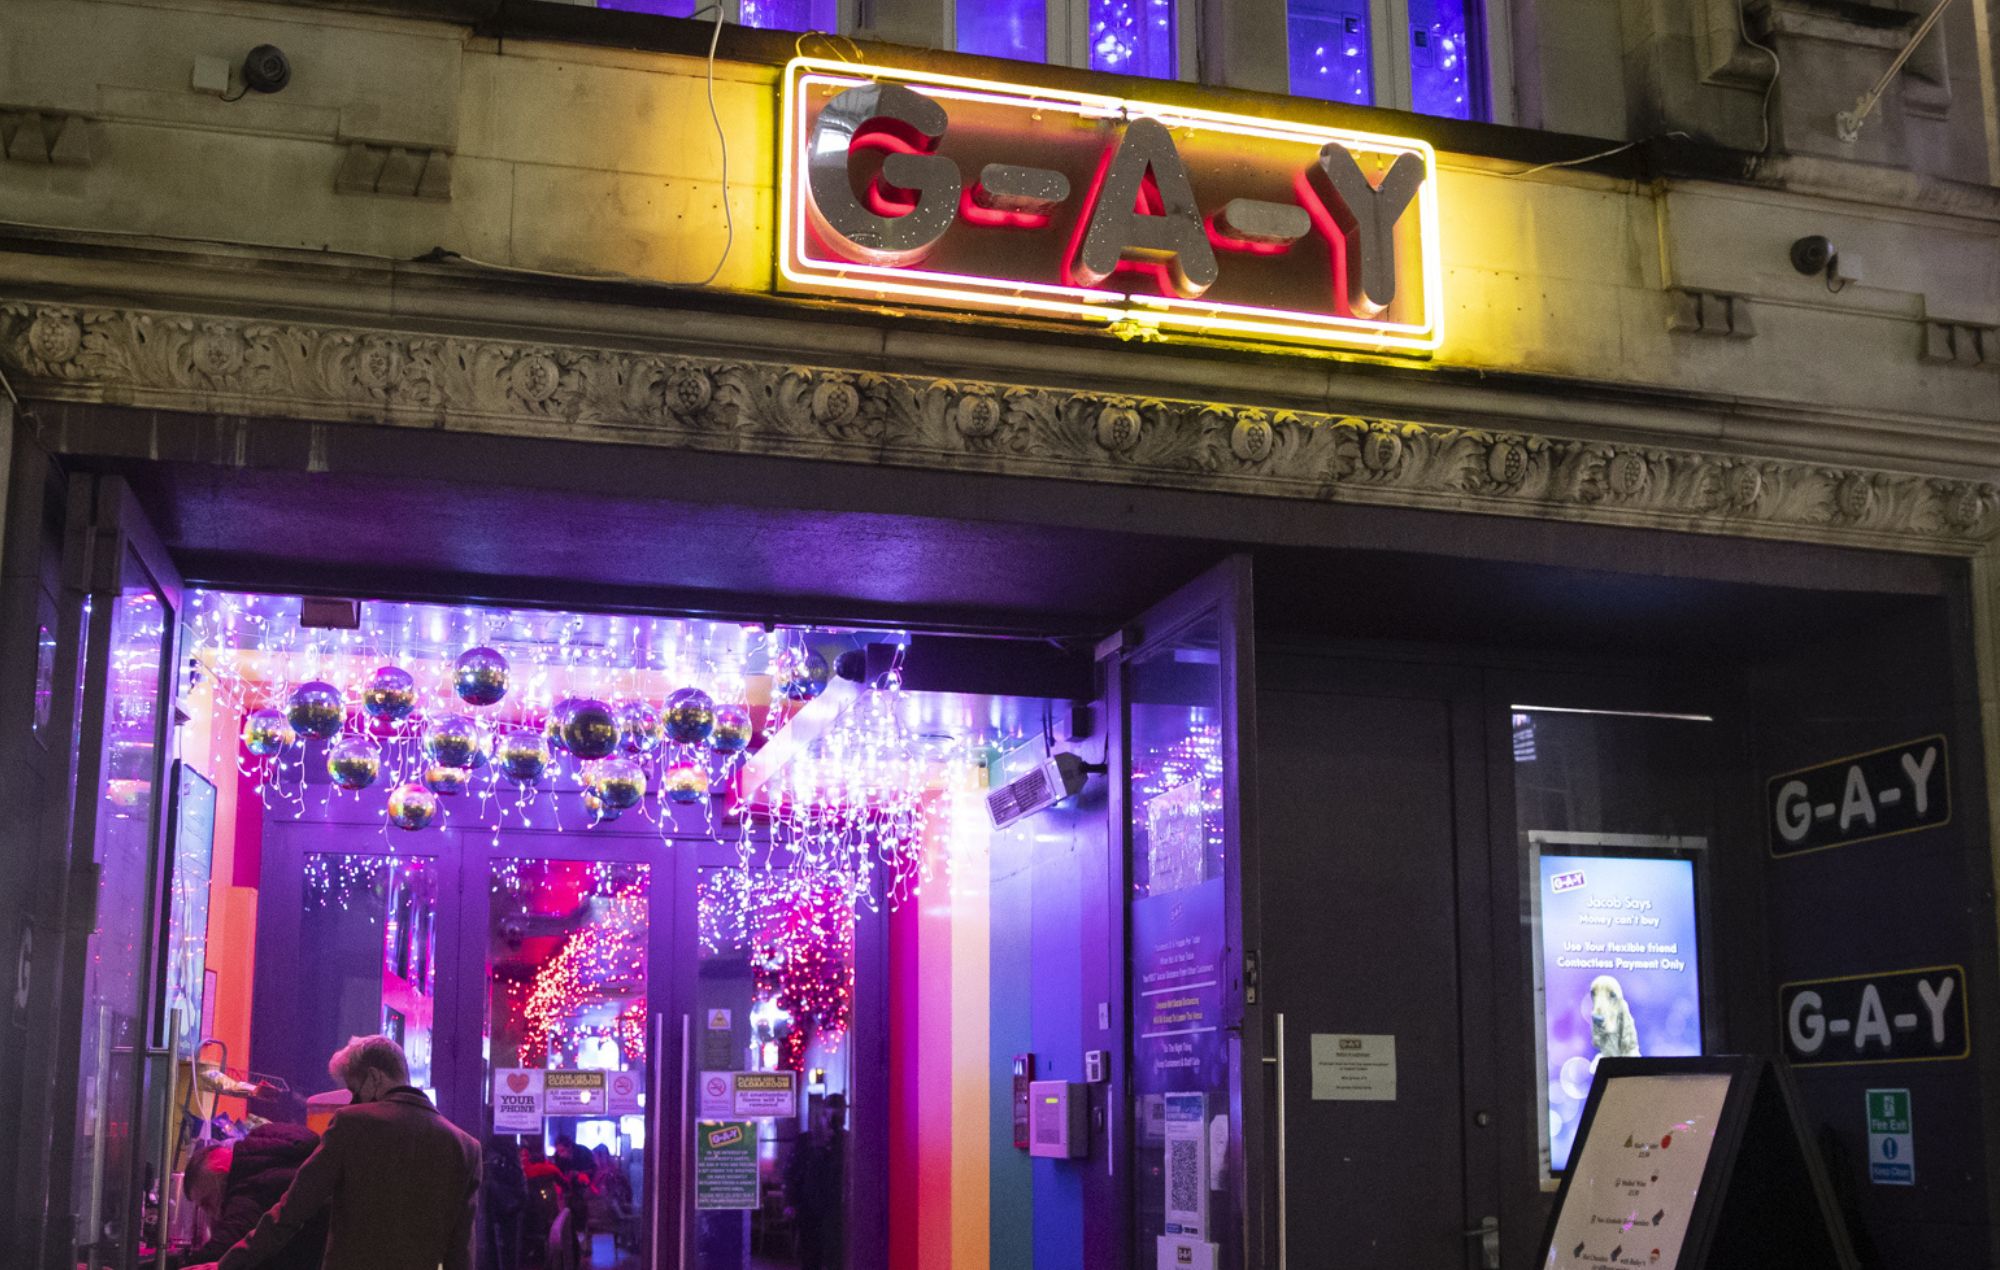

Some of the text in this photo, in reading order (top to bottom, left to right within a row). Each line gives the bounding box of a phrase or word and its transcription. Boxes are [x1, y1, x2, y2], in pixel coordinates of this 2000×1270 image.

[808, 82, 1426, 320] G-A-Y
[1775, 746, 1937, 843] G-A-Y
[1554, 873, 1583, 890] G-A-Y
[1587, 896, 1653, 912] Jacob Says
[1579, 915, 1661, 928] Money can't buy
[1563, 941, 1583, 952] Use
[1608, 942, 1647, 953] flexible
[1647, 942, 1678, 954] friend
[1557, 957, 1686, 972] Contactless Payment Only
[1788, 976, 1955, 1053] G-A-Y
[500, 1096, 535, 1104] YOUR
[500, 1105, 535, 1113] PHONE
[1872, 1119, 1907, 1131] Fire Exit
